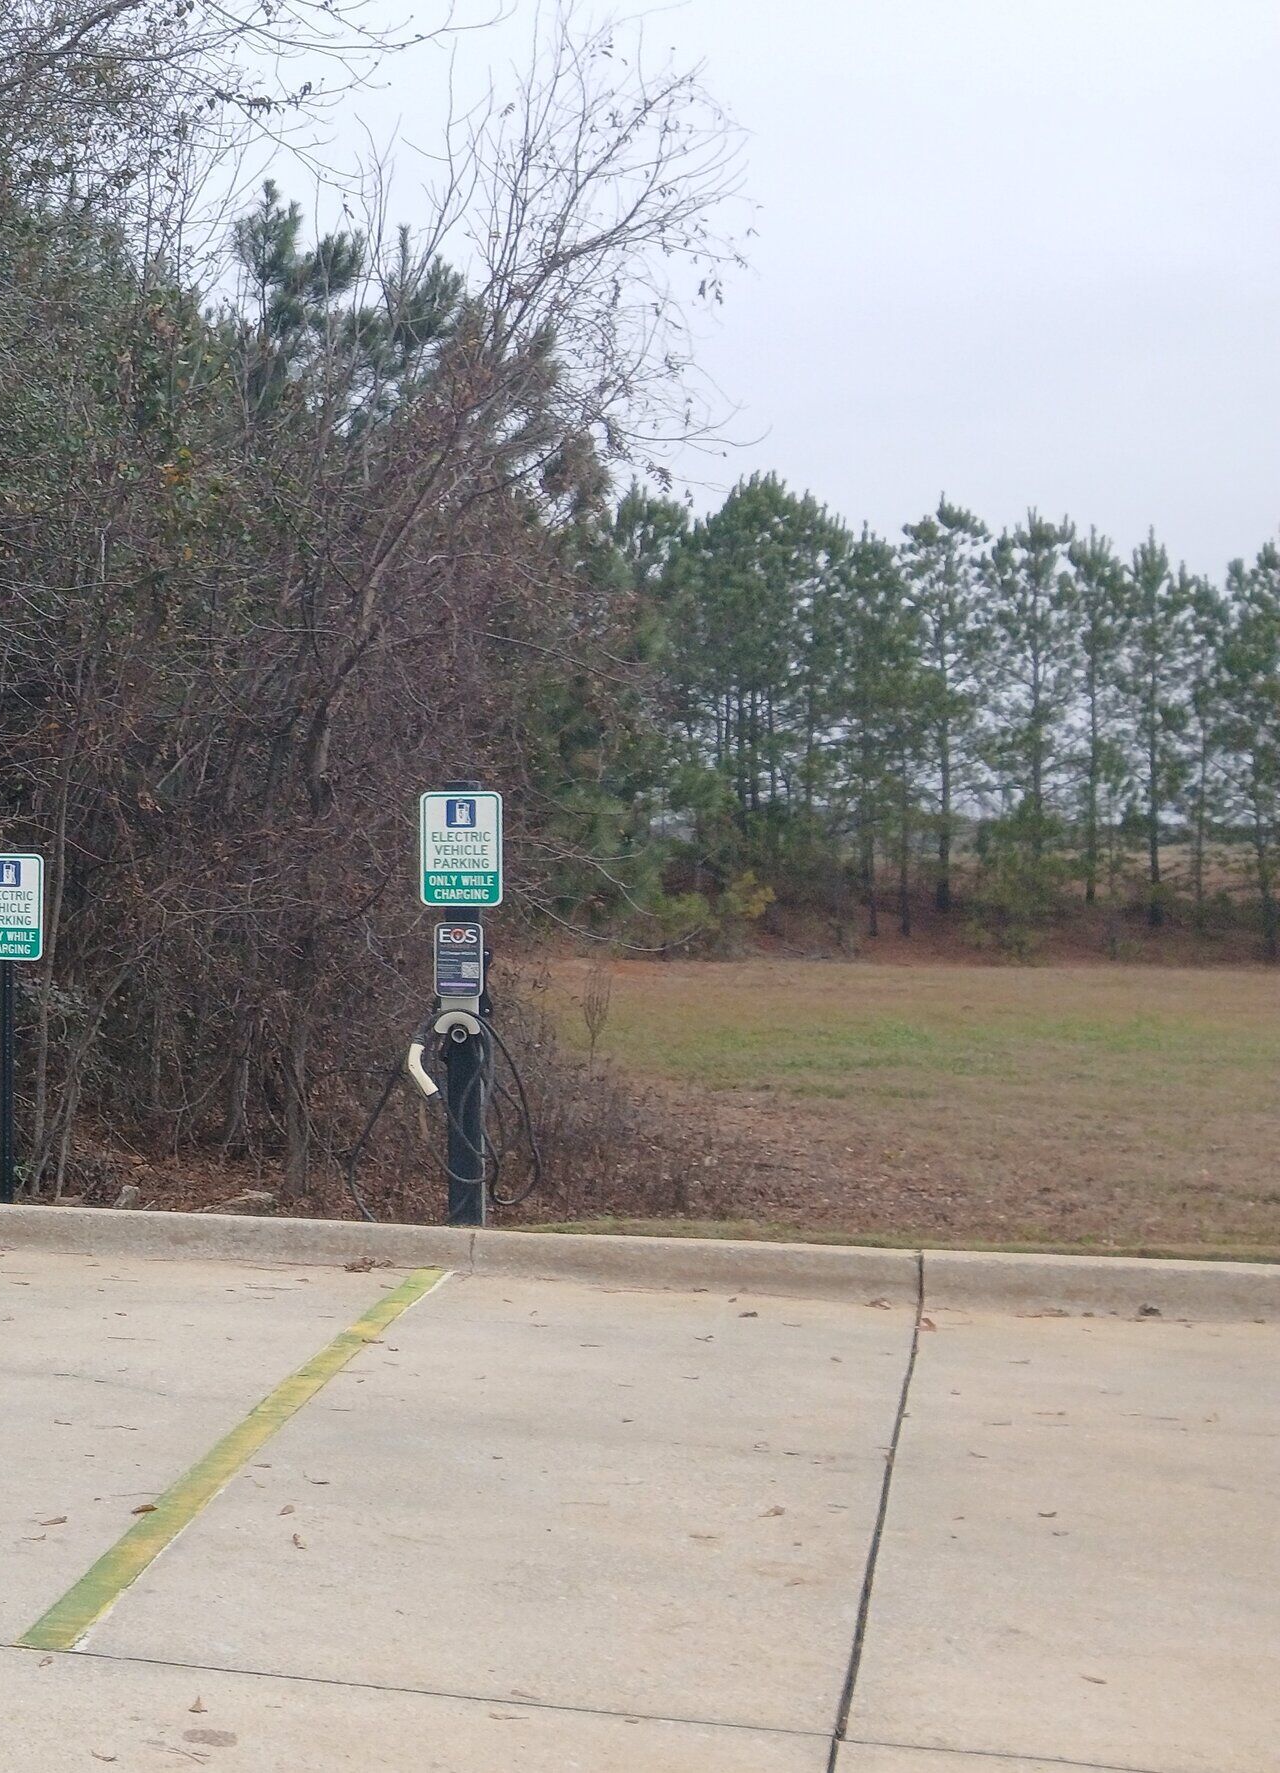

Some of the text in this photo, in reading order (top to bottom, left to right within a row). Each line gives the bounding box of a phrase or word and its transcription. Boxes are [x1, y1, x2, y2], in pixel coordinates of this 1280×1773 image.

[431, 831, 491, 842] ELECTRIC
[434, 844, 489, 855] VEHICLE
[433, 858, 490, 868] PARKING
[428, 875, 494, 886] ONLY WHILE
[434, 889, 489, 900] CHARGING
[6, 931, 36, 942] WHILE
[439, 928, 478, 944] EOS
